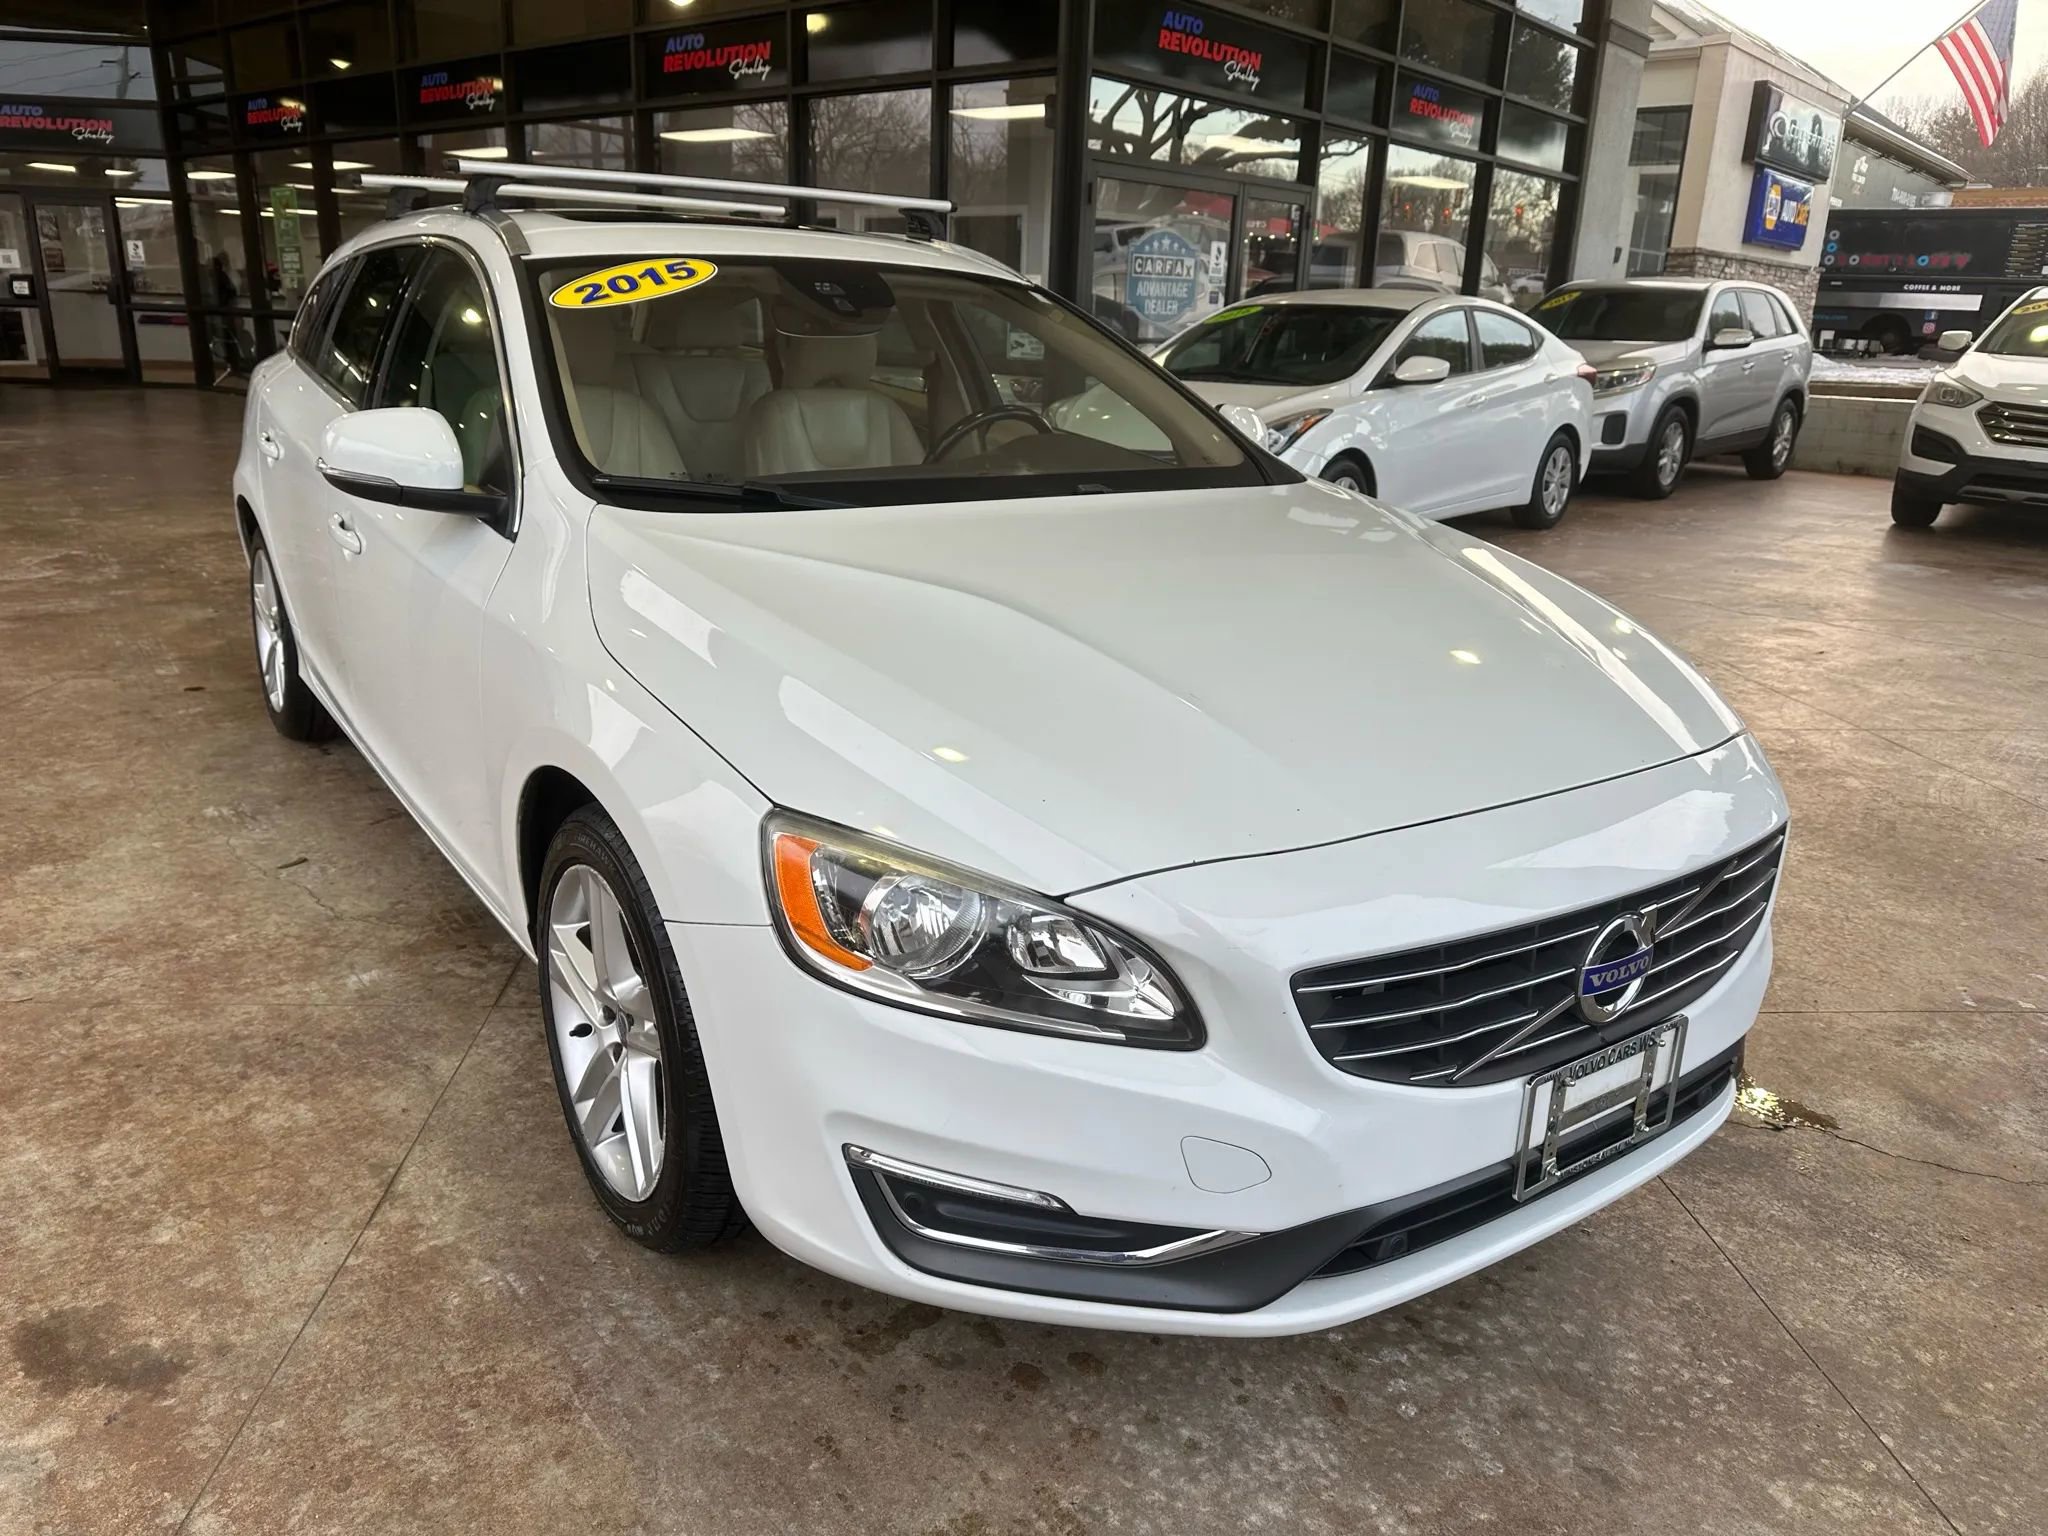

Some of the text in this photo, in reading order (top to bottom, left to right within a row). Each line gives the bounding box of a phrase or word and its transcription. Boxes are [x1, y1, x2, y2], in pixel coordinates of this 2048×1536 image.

[1163, 11, 1204, 34] AUTO
[666, 33, 704, 53] AUTO
[1159, 29, 1262, 71] REVOLUTION
[664, 41, 772, 73] REVOLUTION
[728, 55, 772, 81] Shelby
[422, 72, 448, 87] AUTO
[1224, 60, 1260, 92] Shelby
[420, 78, 494, 104] REVOLUTION
[1413, 84, 1440, 102] AUTO
[1, 105, 43, 116] AUTO
[1409, 97, 1475, 128] REVOLUTION
[0, 116, 113, 131] REVOLUTION
[72, 127, 115, 144] Shelby
[1134, 256, 1193, 277] CARFAX
[574, 261, 699, 304] 2015
[1136, 281, 1189, 298] ADVANTAGE
[1144, 299, 1179, 315] DEALER
[1589, 956, 1649, 987] VOLVO
[1569, 1055, 1606, 1079] VOLVO
[1607, 1040, 1637, 1066] CARS
